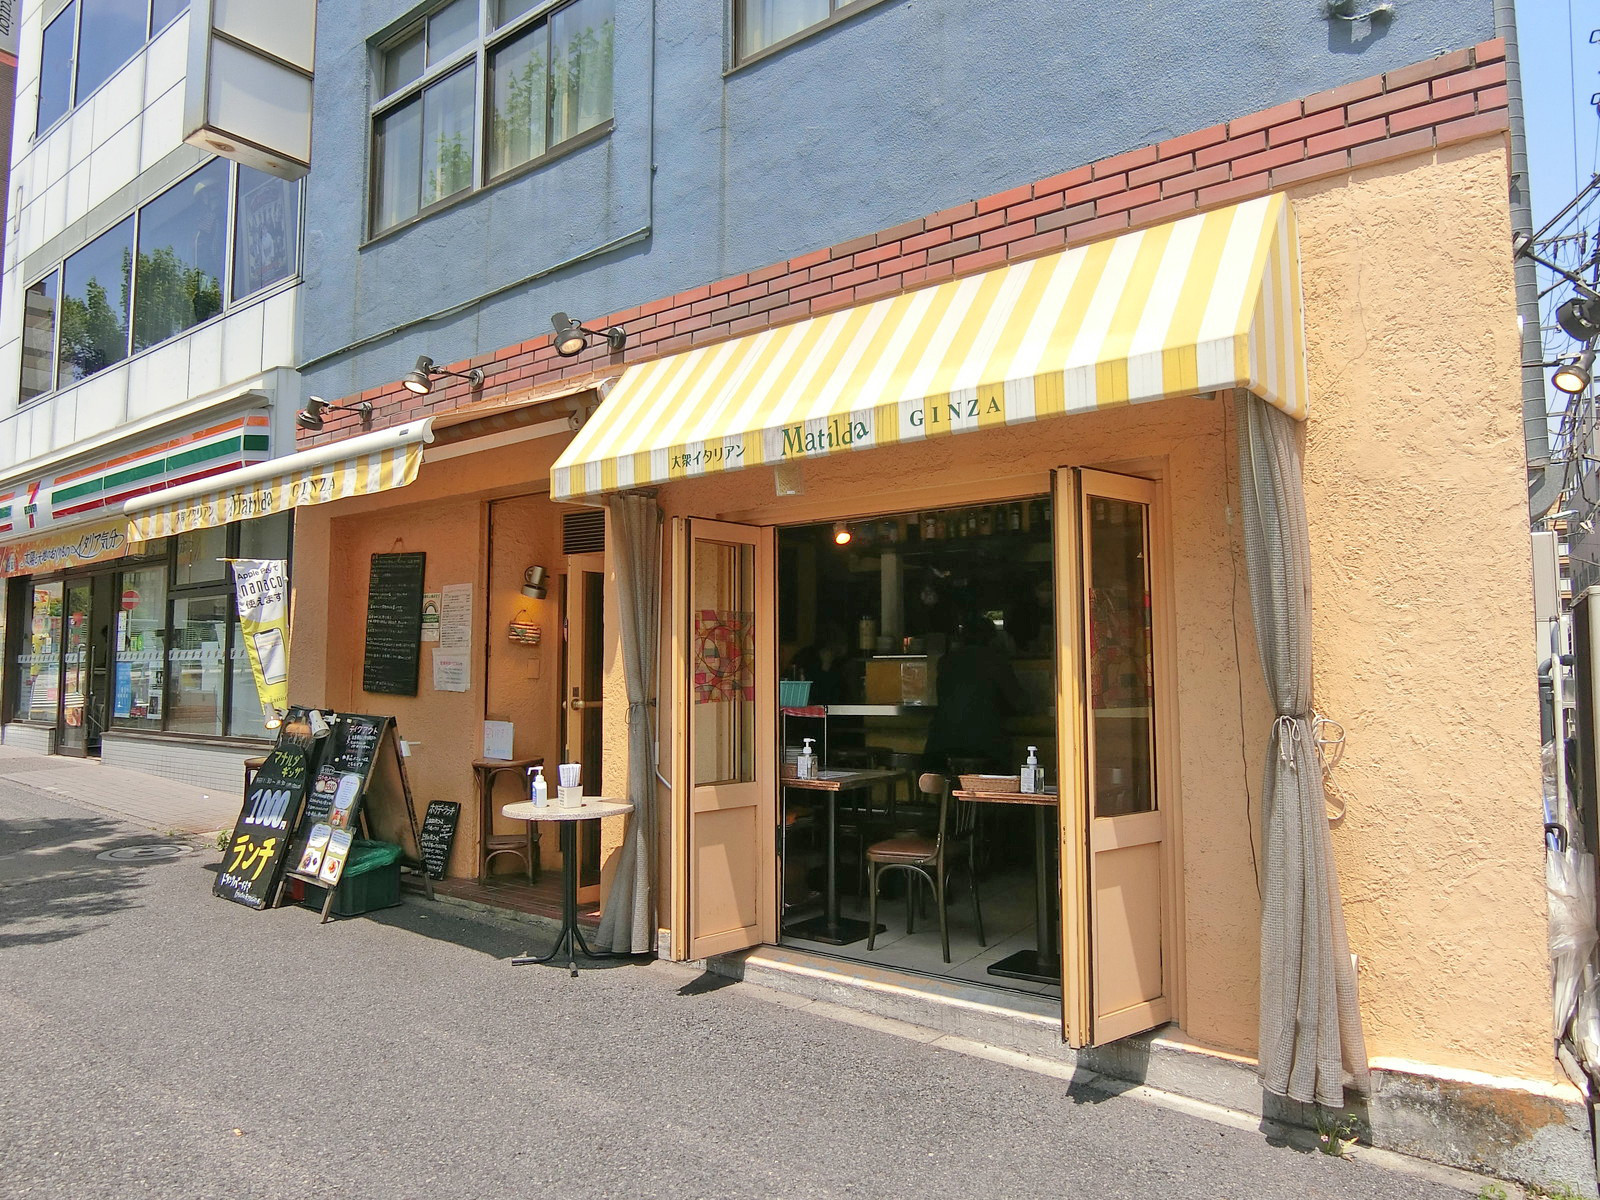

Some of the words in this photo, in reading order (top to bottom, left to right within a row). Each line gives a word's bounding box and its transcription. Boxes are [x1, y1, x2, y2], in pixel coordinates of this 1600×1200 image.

[671, 443, 746, 470] 大衆イタリアン
[781, 419, 869, 457] Matilda
[909, 396, 1001, 428] GINZA
[229, 490, 273, 516] Matilda
[292, 476, 336, 498] GINZA
[237, 570, 259, 580] Apple
[240, 576, 283, 597] nanaco
[246, 592, 282, 609] 使えます
[228, 834, 277, 881] ランチ
